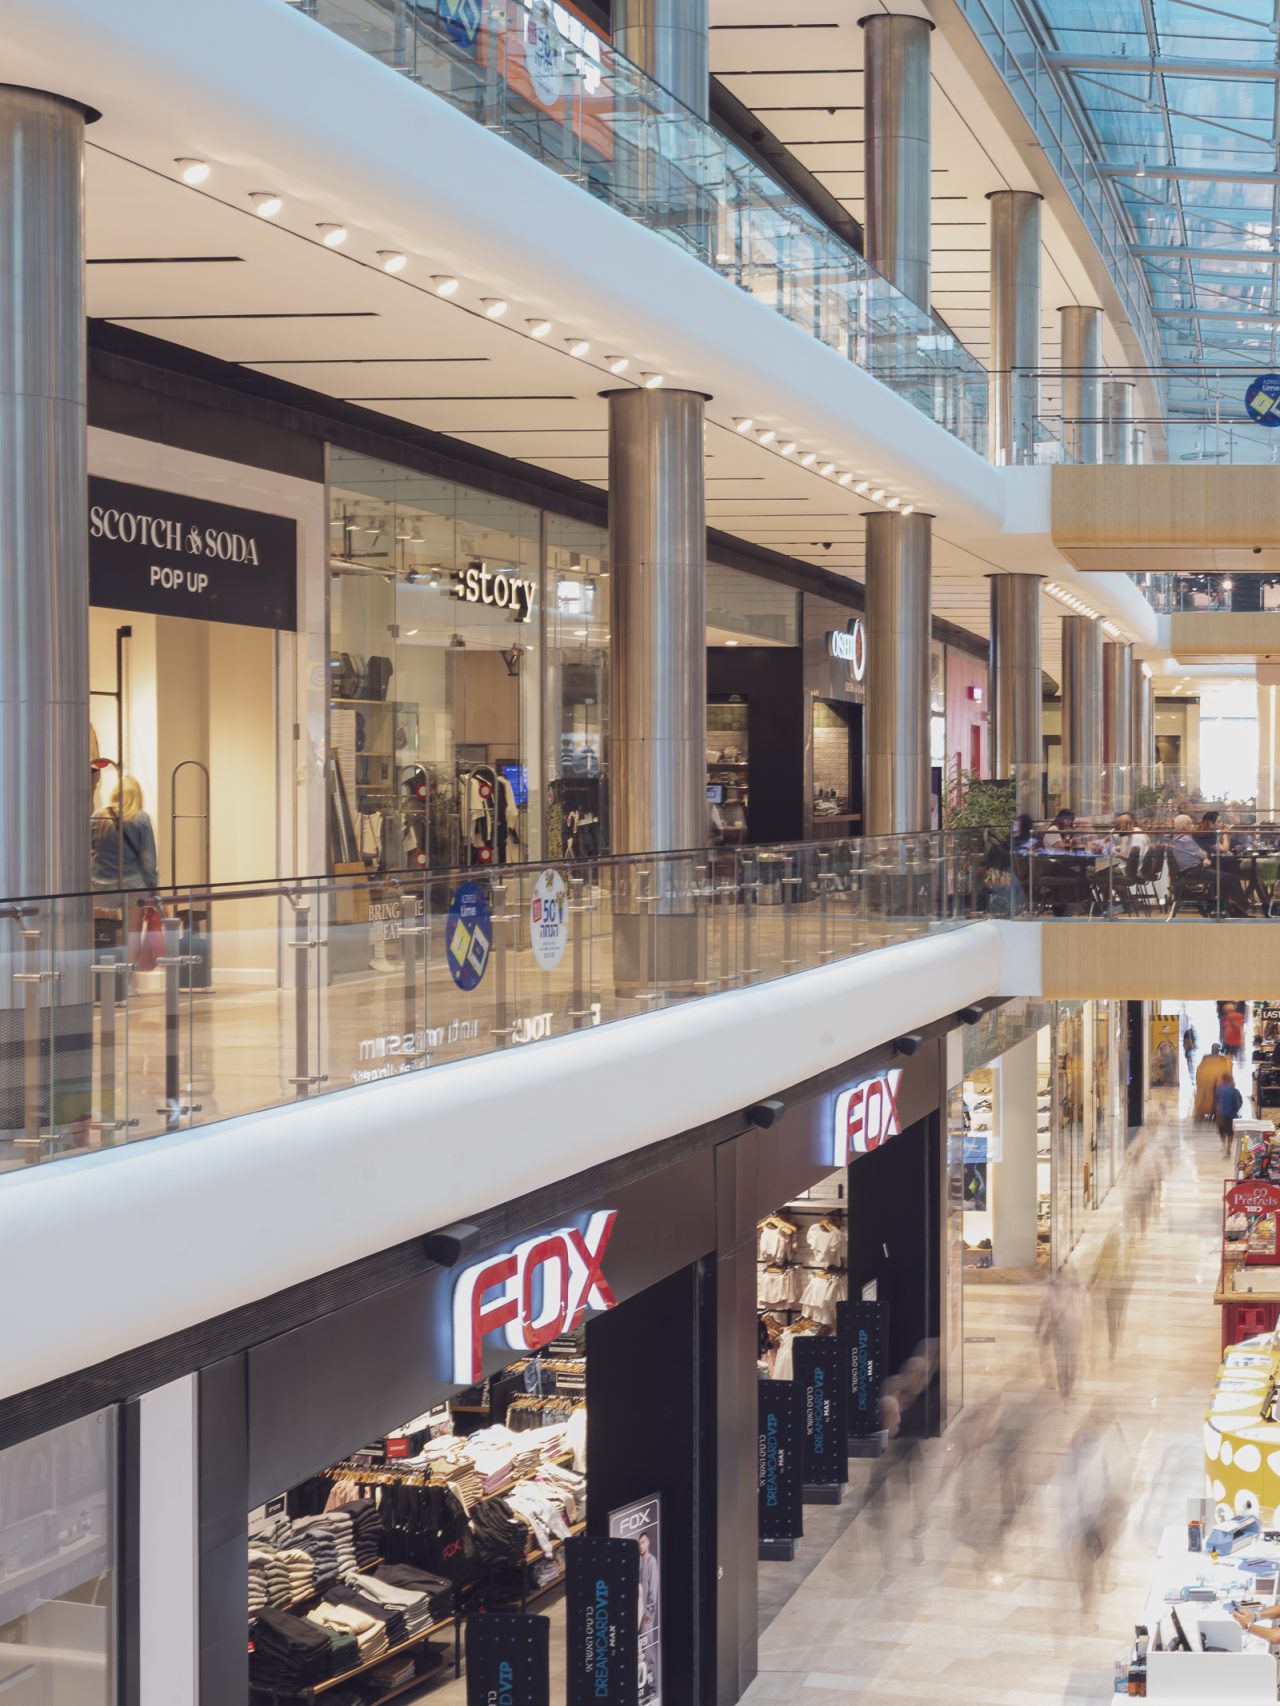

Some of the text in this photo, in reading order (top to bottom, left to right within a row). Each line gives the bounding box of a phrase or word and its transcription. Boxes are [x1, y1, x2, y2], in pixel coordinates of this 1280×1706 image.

[90, 506, 259, 566] SCOTCH & SODA
[151, 566, 209, 593] POP UP
[368, 902, 400, 922] BRING
[834, 1068, 903, 1168] FOX
[1234, 1193, 1277, 1205] Pretzels
[454, 1210, 618, 1385] FOX
[619, 1508, 650, 1535] FOX
